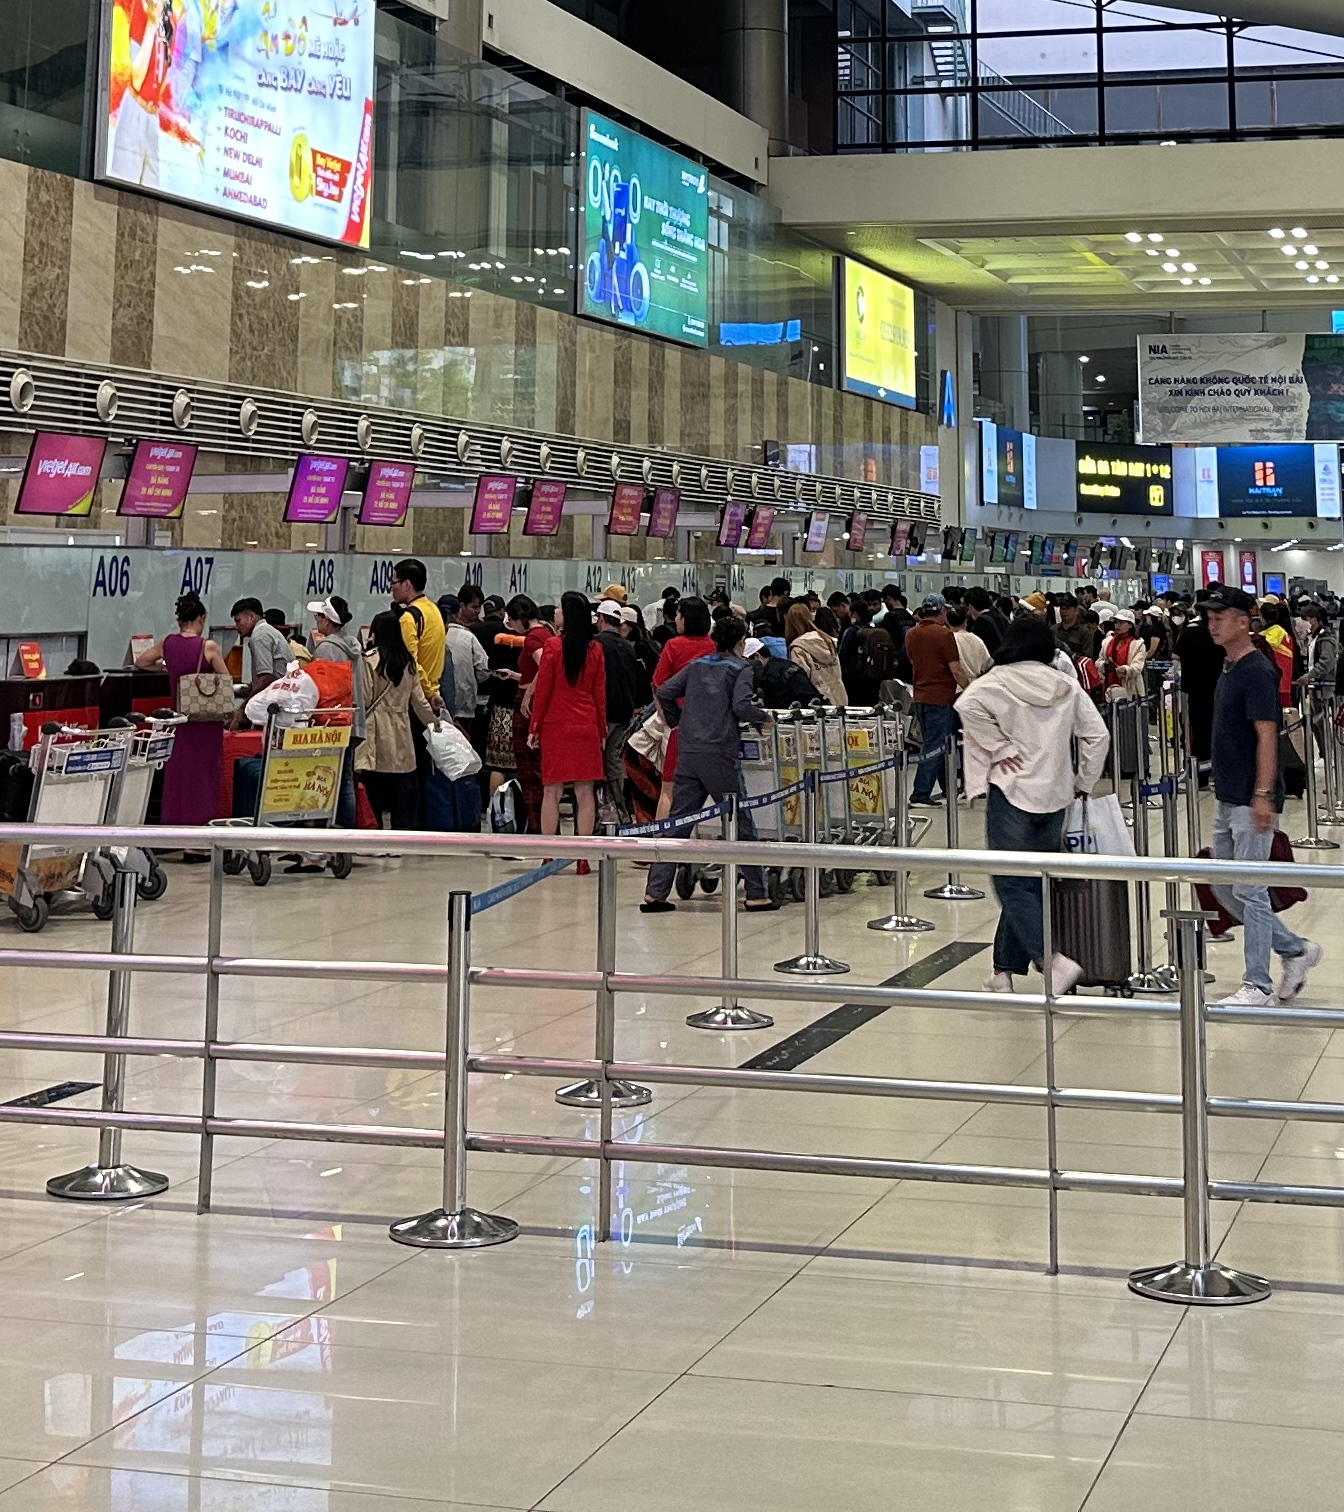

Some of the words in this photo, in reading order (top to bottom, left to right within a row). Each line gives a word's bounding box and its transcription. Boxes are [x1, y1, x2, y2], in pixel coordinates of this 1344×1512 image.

[224, 125, 248, 145] KOCHI
[223, 146, 241, 163] NEW
[242, 151, 263, 169] DELHI
[223, 167, 253, 186] MUMBAI
[1148, 344, 1168, 355] NIA
[942, 369, 956, 428] A
[93, 555, 131, 597] A06
[180, 556, 213, 595] A07
[306, 559, 334, 595] A08
[369, 560, 393, 594] A09
[464, 562, 483, 587] A10
[509, 563, 527, 593] A11
[585, 565, 602, 593] A12
[621, 566, 636, 593] A13
[682, 567, 695, 593] A14
[292, 733, 309, 745] BIA
[310, 730, 324, 743] HÀ
[325, 729, 342, 747] NỘI
